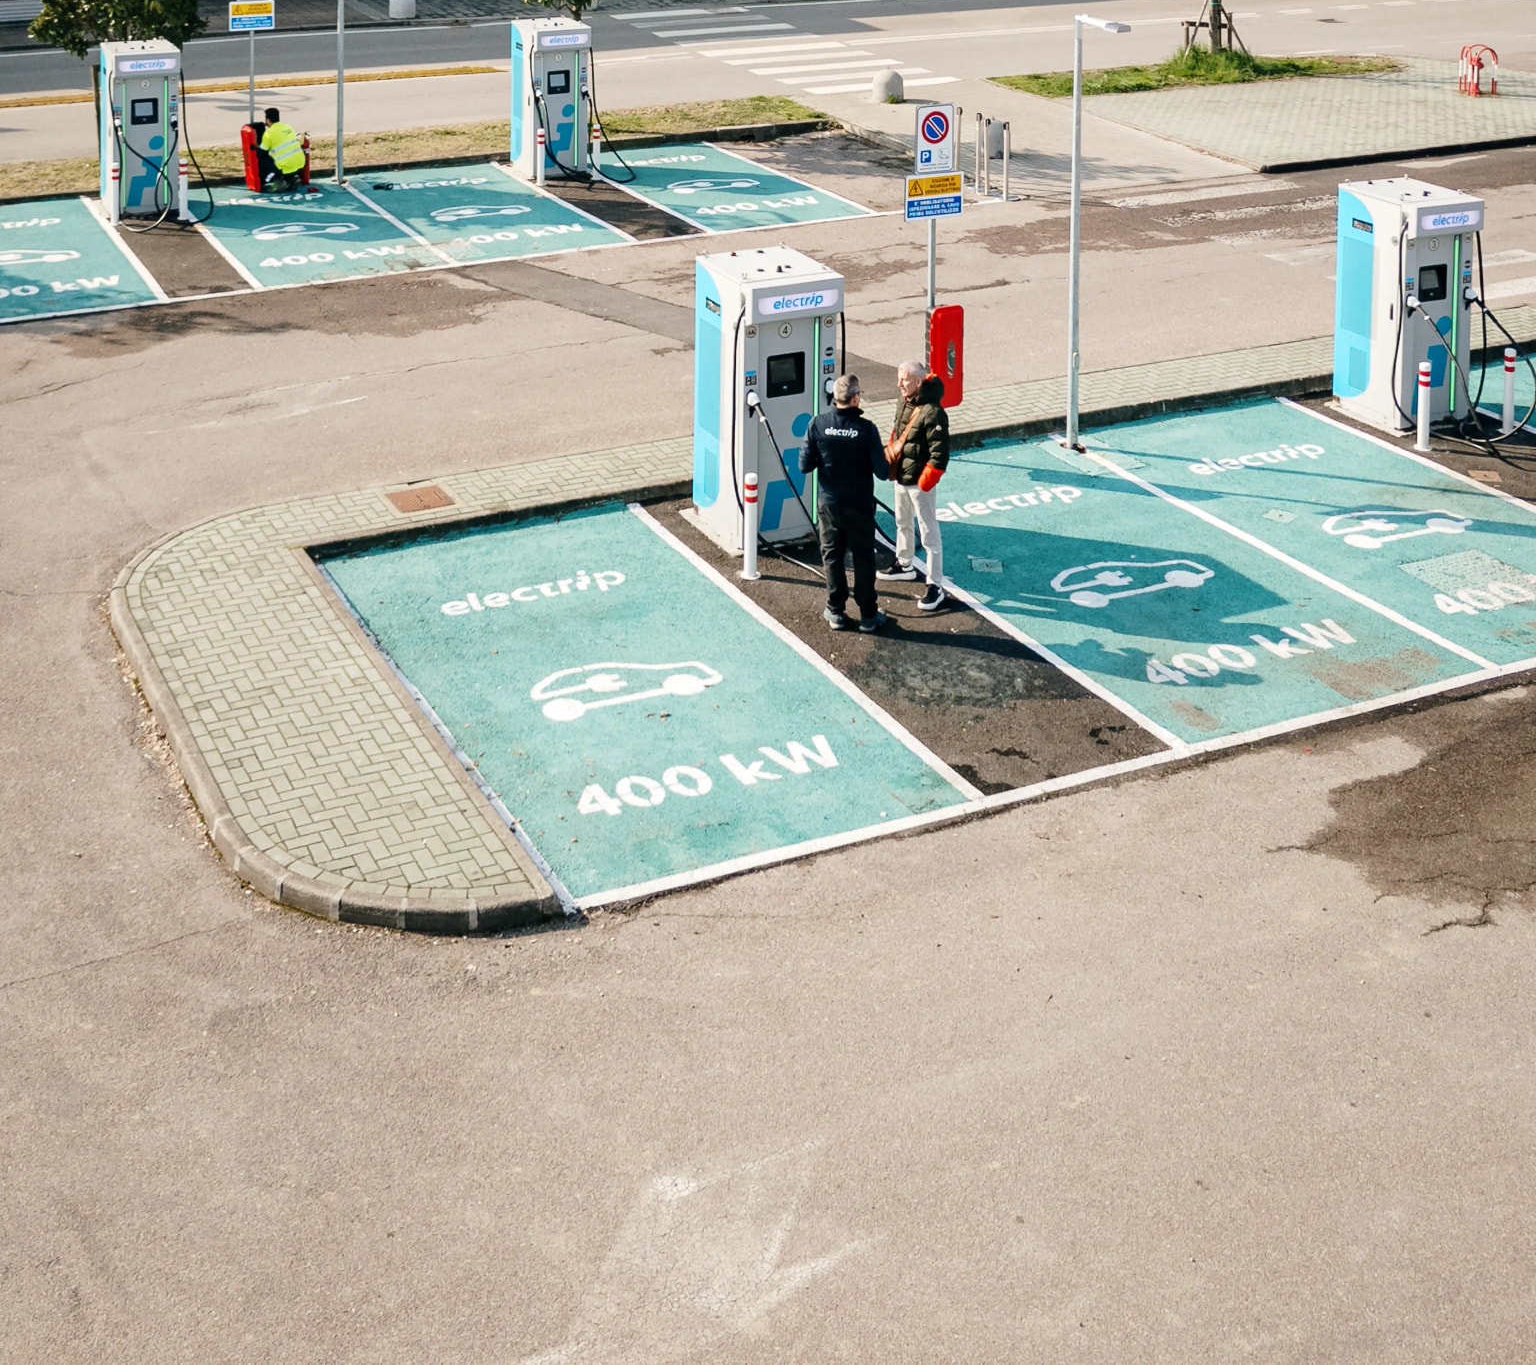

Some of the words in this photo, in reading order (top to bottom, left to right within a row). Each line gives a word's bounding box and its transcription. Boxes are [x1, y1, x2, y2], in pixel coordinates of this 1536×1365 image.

[549, 35, 580, 44] electrip
[130, 60, 166, 70] electrip
[613, 154, 706, 167] electrip
[922, 152, 930, 162] P
[696, 201, 759, 215] 400
[762, 195, 819, 209] kW
[1432, 213, 1470, 226] electrip
[524, 223, 584, 237] kW
[259, 252, 334, 267] 400
[343, 245, 405, 259] kW
[50, 275, 119, 292] kW
[773, 292, 823, 310] electrip
[782, 326, 788, 335] 4
[824, 427, 858, 438] electrip
[1188, 444, 1326, 476] electrip
[936, 485, 1082, 521] electrip
[441, 570, 626, 616] electrip
[1433, 582, 1535, 615] 400
[1145, 644, 1257, 684] 400
[1249, 618, 1357, 659] kW
[577, 765, 713, 816] 400
[719, 734, 839, 786] kW
